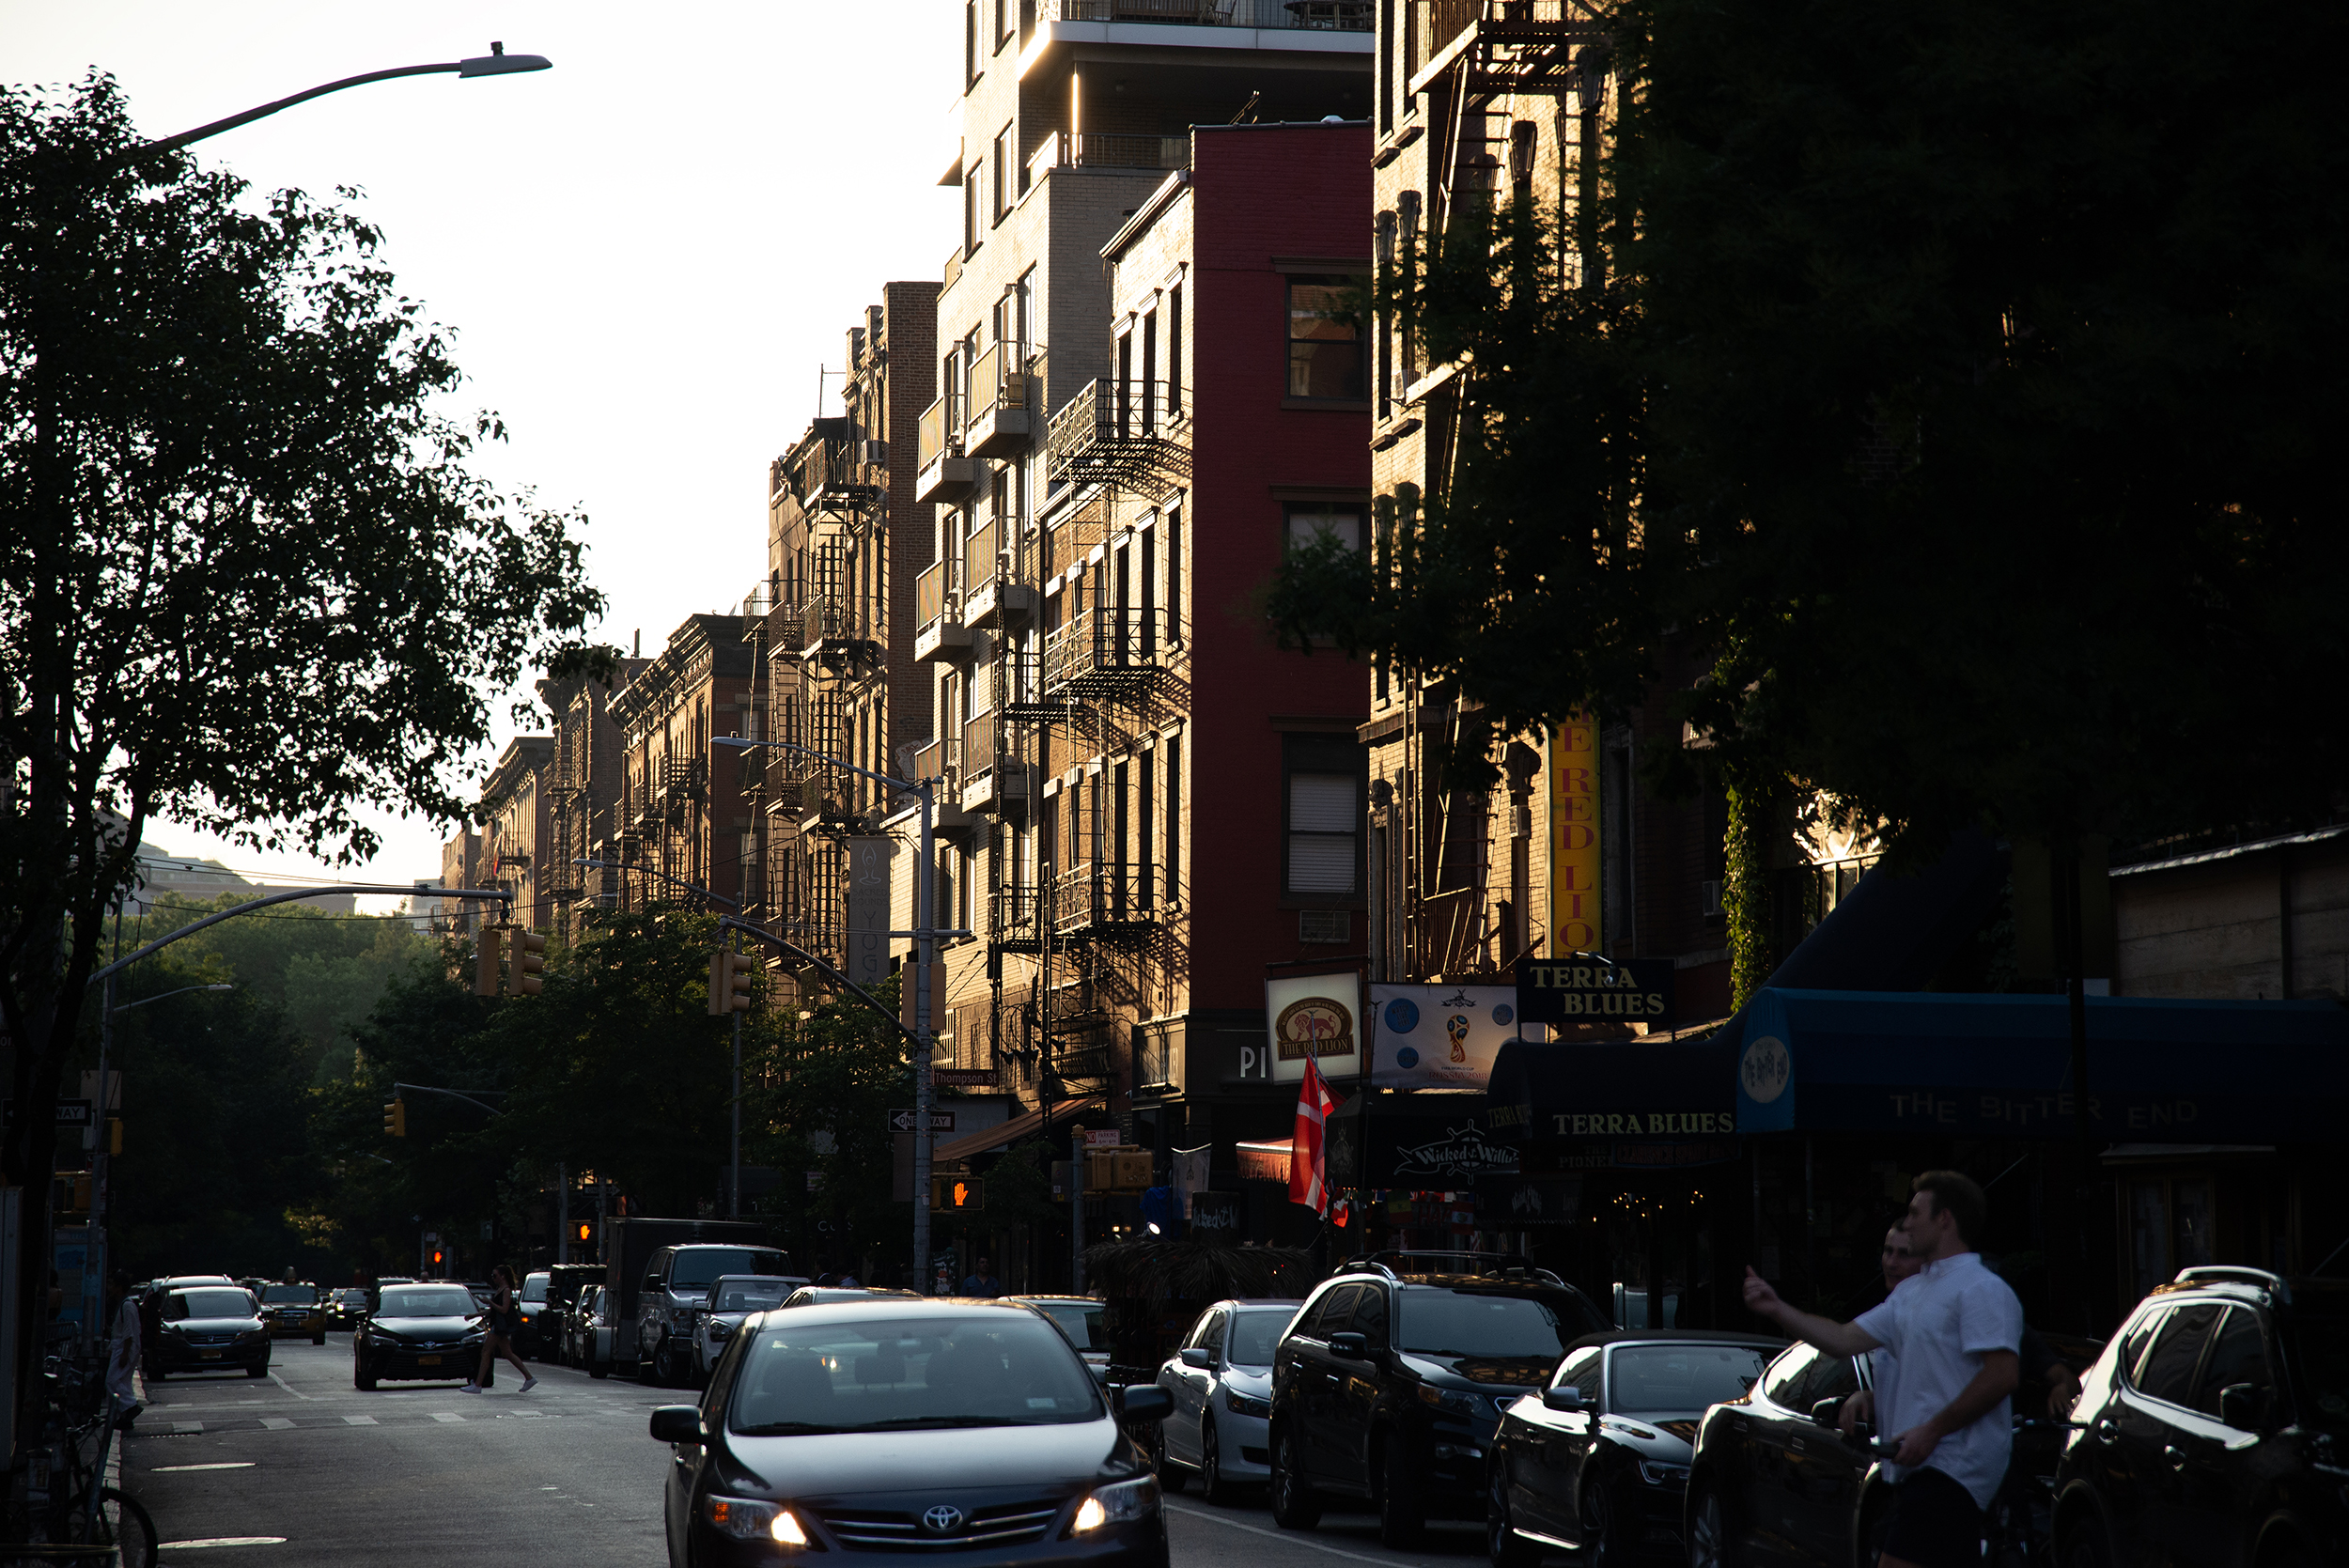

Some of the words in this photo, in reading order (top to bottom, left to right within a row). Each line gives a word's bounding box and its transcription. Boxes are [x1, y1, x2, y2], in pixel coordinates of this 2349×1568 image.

[1557, 768, 1595, 850] RED
[852, 888, 888, 896] SACRED
[851, 898, 889, 907] SOUNDS
[1559, 865, 1595, 958] LIO
[1529, 966, 1639, 988] TERRA
[1563, 992, 1666, 1015] BLUES
[1283, 1042, 1301, 1055] THE
[1303, 1040, 1323, 1053] RED
[1325, 1038, 1349, 1051] LION
[935, 1072, 984, 1085] Thompson
[987, 1072, 997, 1083] St
[1428, 1071, 1465, 1079] RUSSIA
[1467, 1071, 1487, 1079] 2018
[1486, 1105, 1518, 1128] TERRA
[1889, 1092, 1957, 1125] THE
[1979, 1092, 2104, 1126] BITTER
[2126, 1099, 2199, 1129] END
[899, 1116, 917, 1126] ONE
[1552, 1113, 1644, 1135] TERRA
[1648, 1112, 1735, 1134] BLUES
[1086, 1132, 1096, 1141] NO
[1415, 1145, 1467, 1165] Wicked
[1583, 1144, 1608, 1156] THE
[1616, 1144, 1674, 1164] CLARENCE
